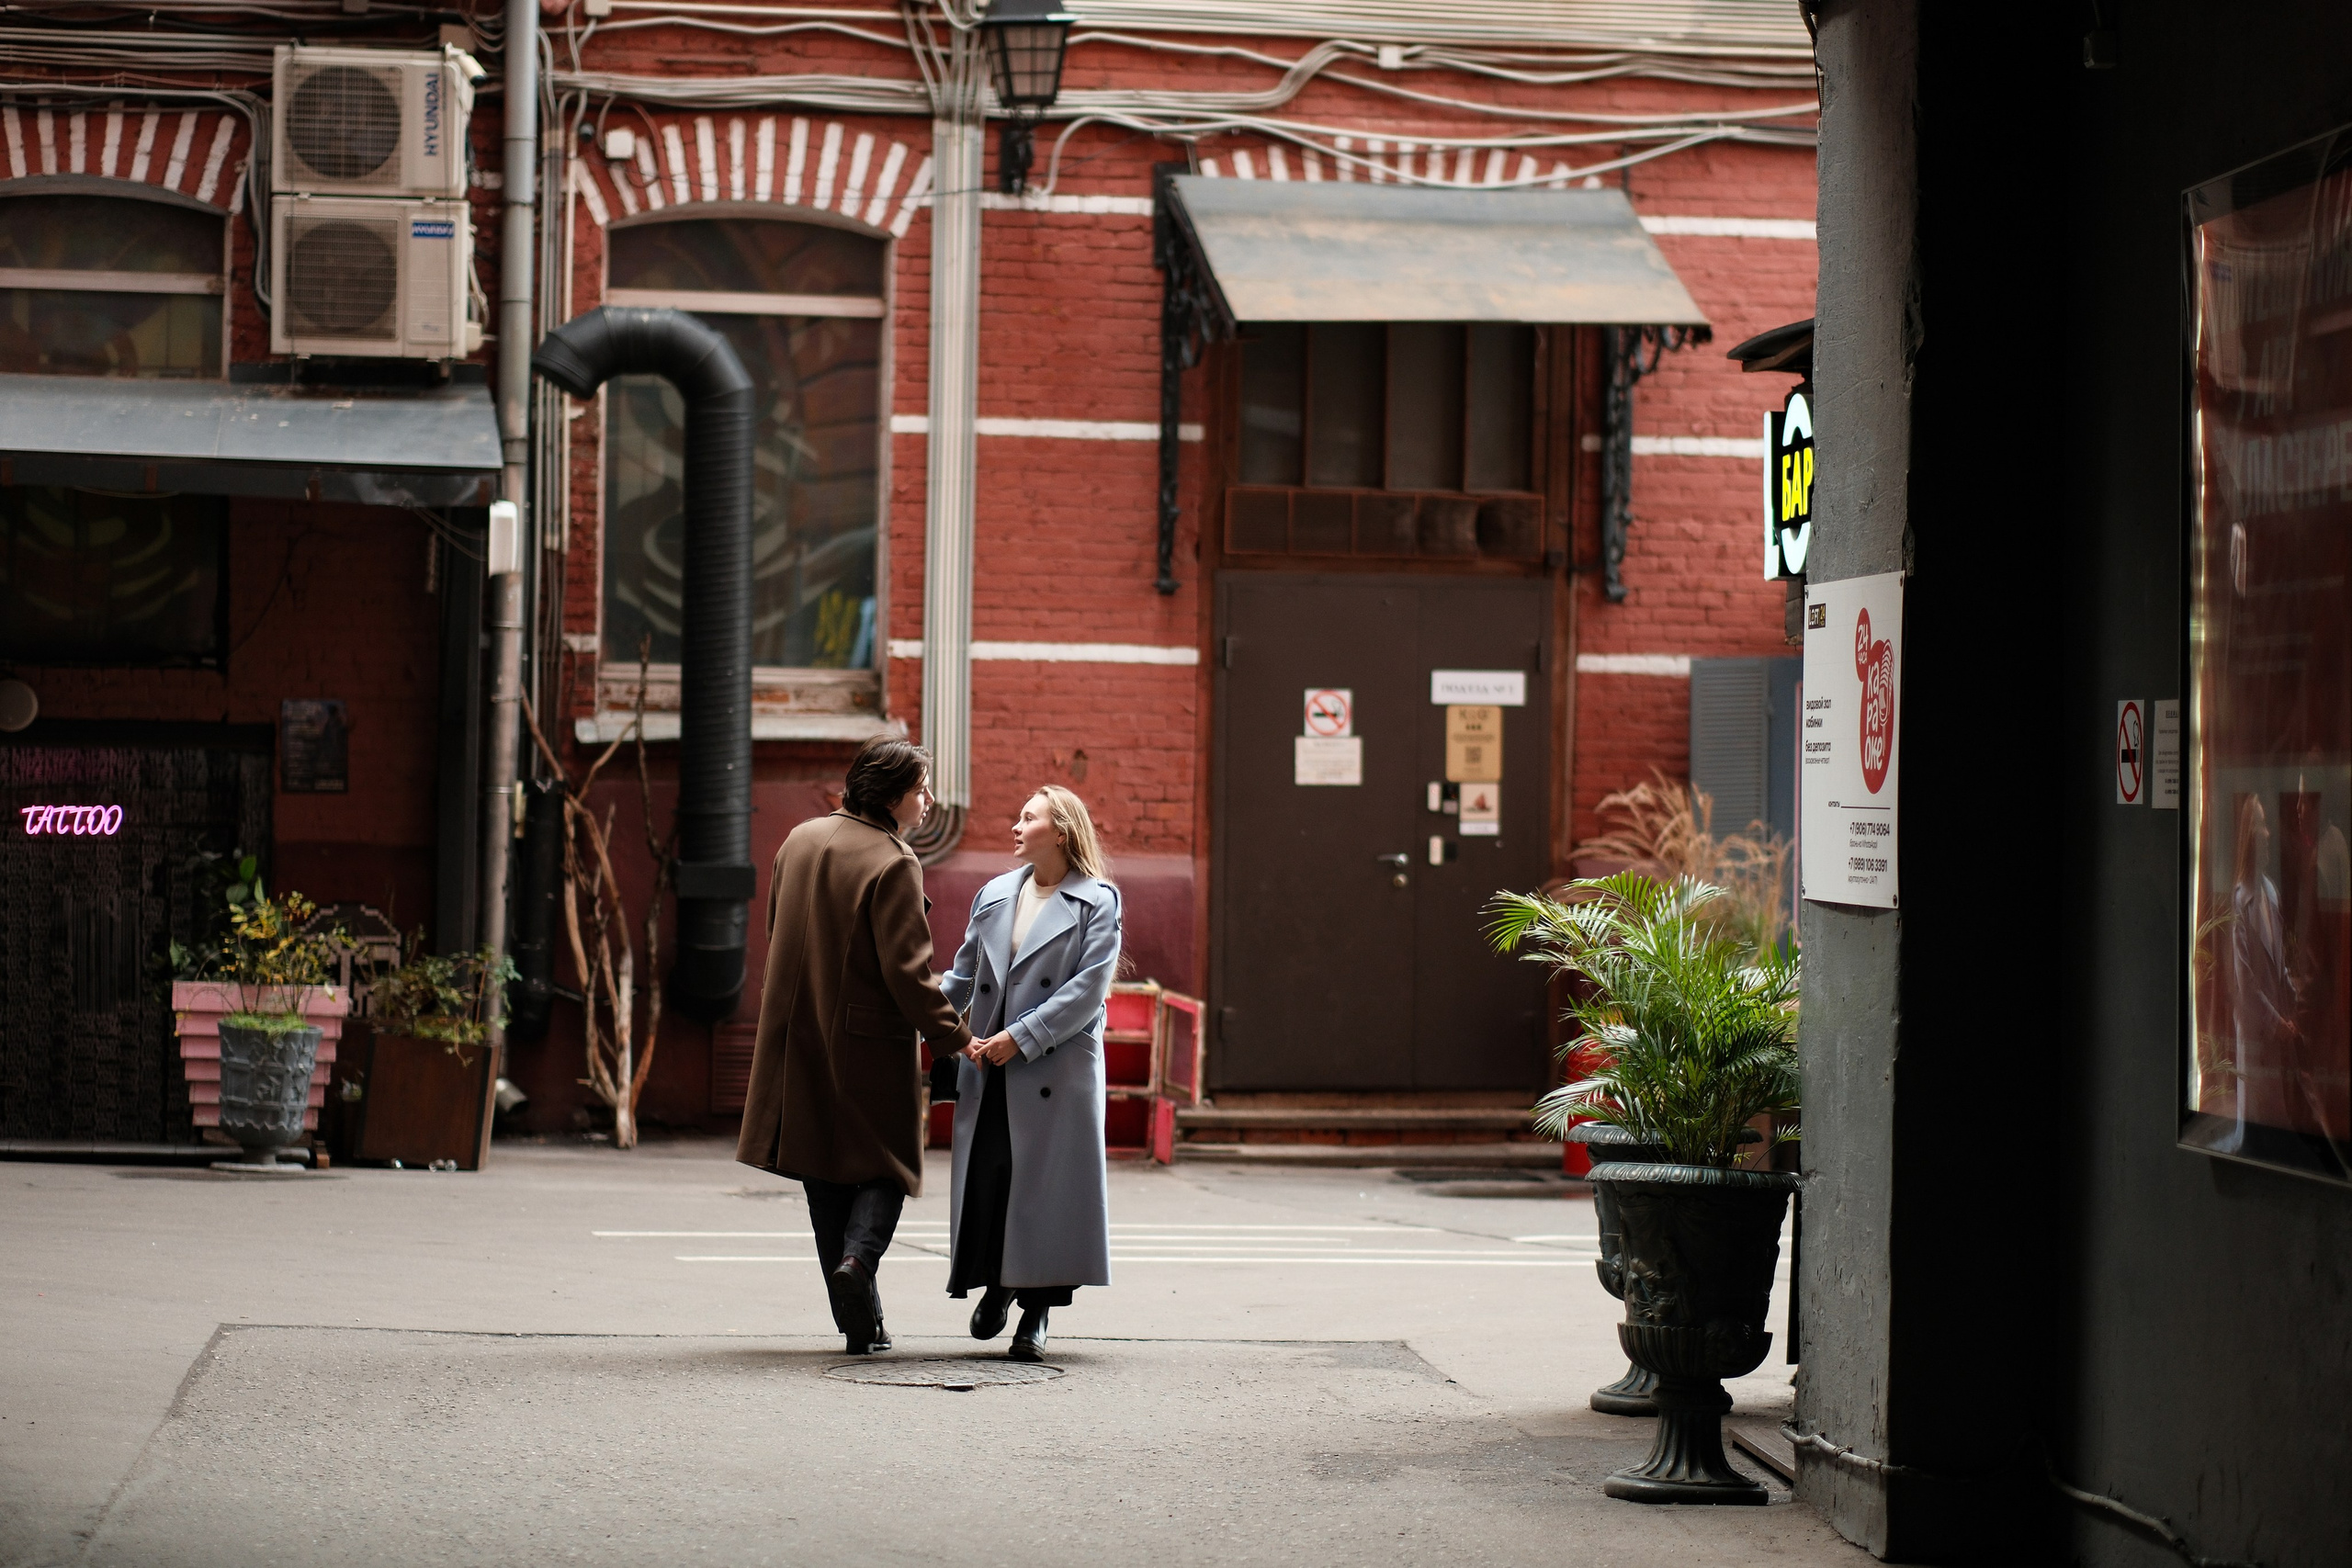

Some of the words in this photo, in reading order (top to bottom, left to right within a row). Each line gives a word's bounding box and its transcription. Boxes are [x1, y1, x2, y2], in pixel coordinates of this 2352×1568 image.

[424, 73, 439, 156] HYUNDAI
[1781, 446, 1814, 522] БАР
[1858, 624, 1869, 651] 24
[1806, 696, 1824, 711] видовой
[1812, 742, 1831, 753] депозита
[20, 805, 123, 836] TATTOO
[1849, 822, 1855, 834] +7
[1849, 857, 1853, 869] +7
